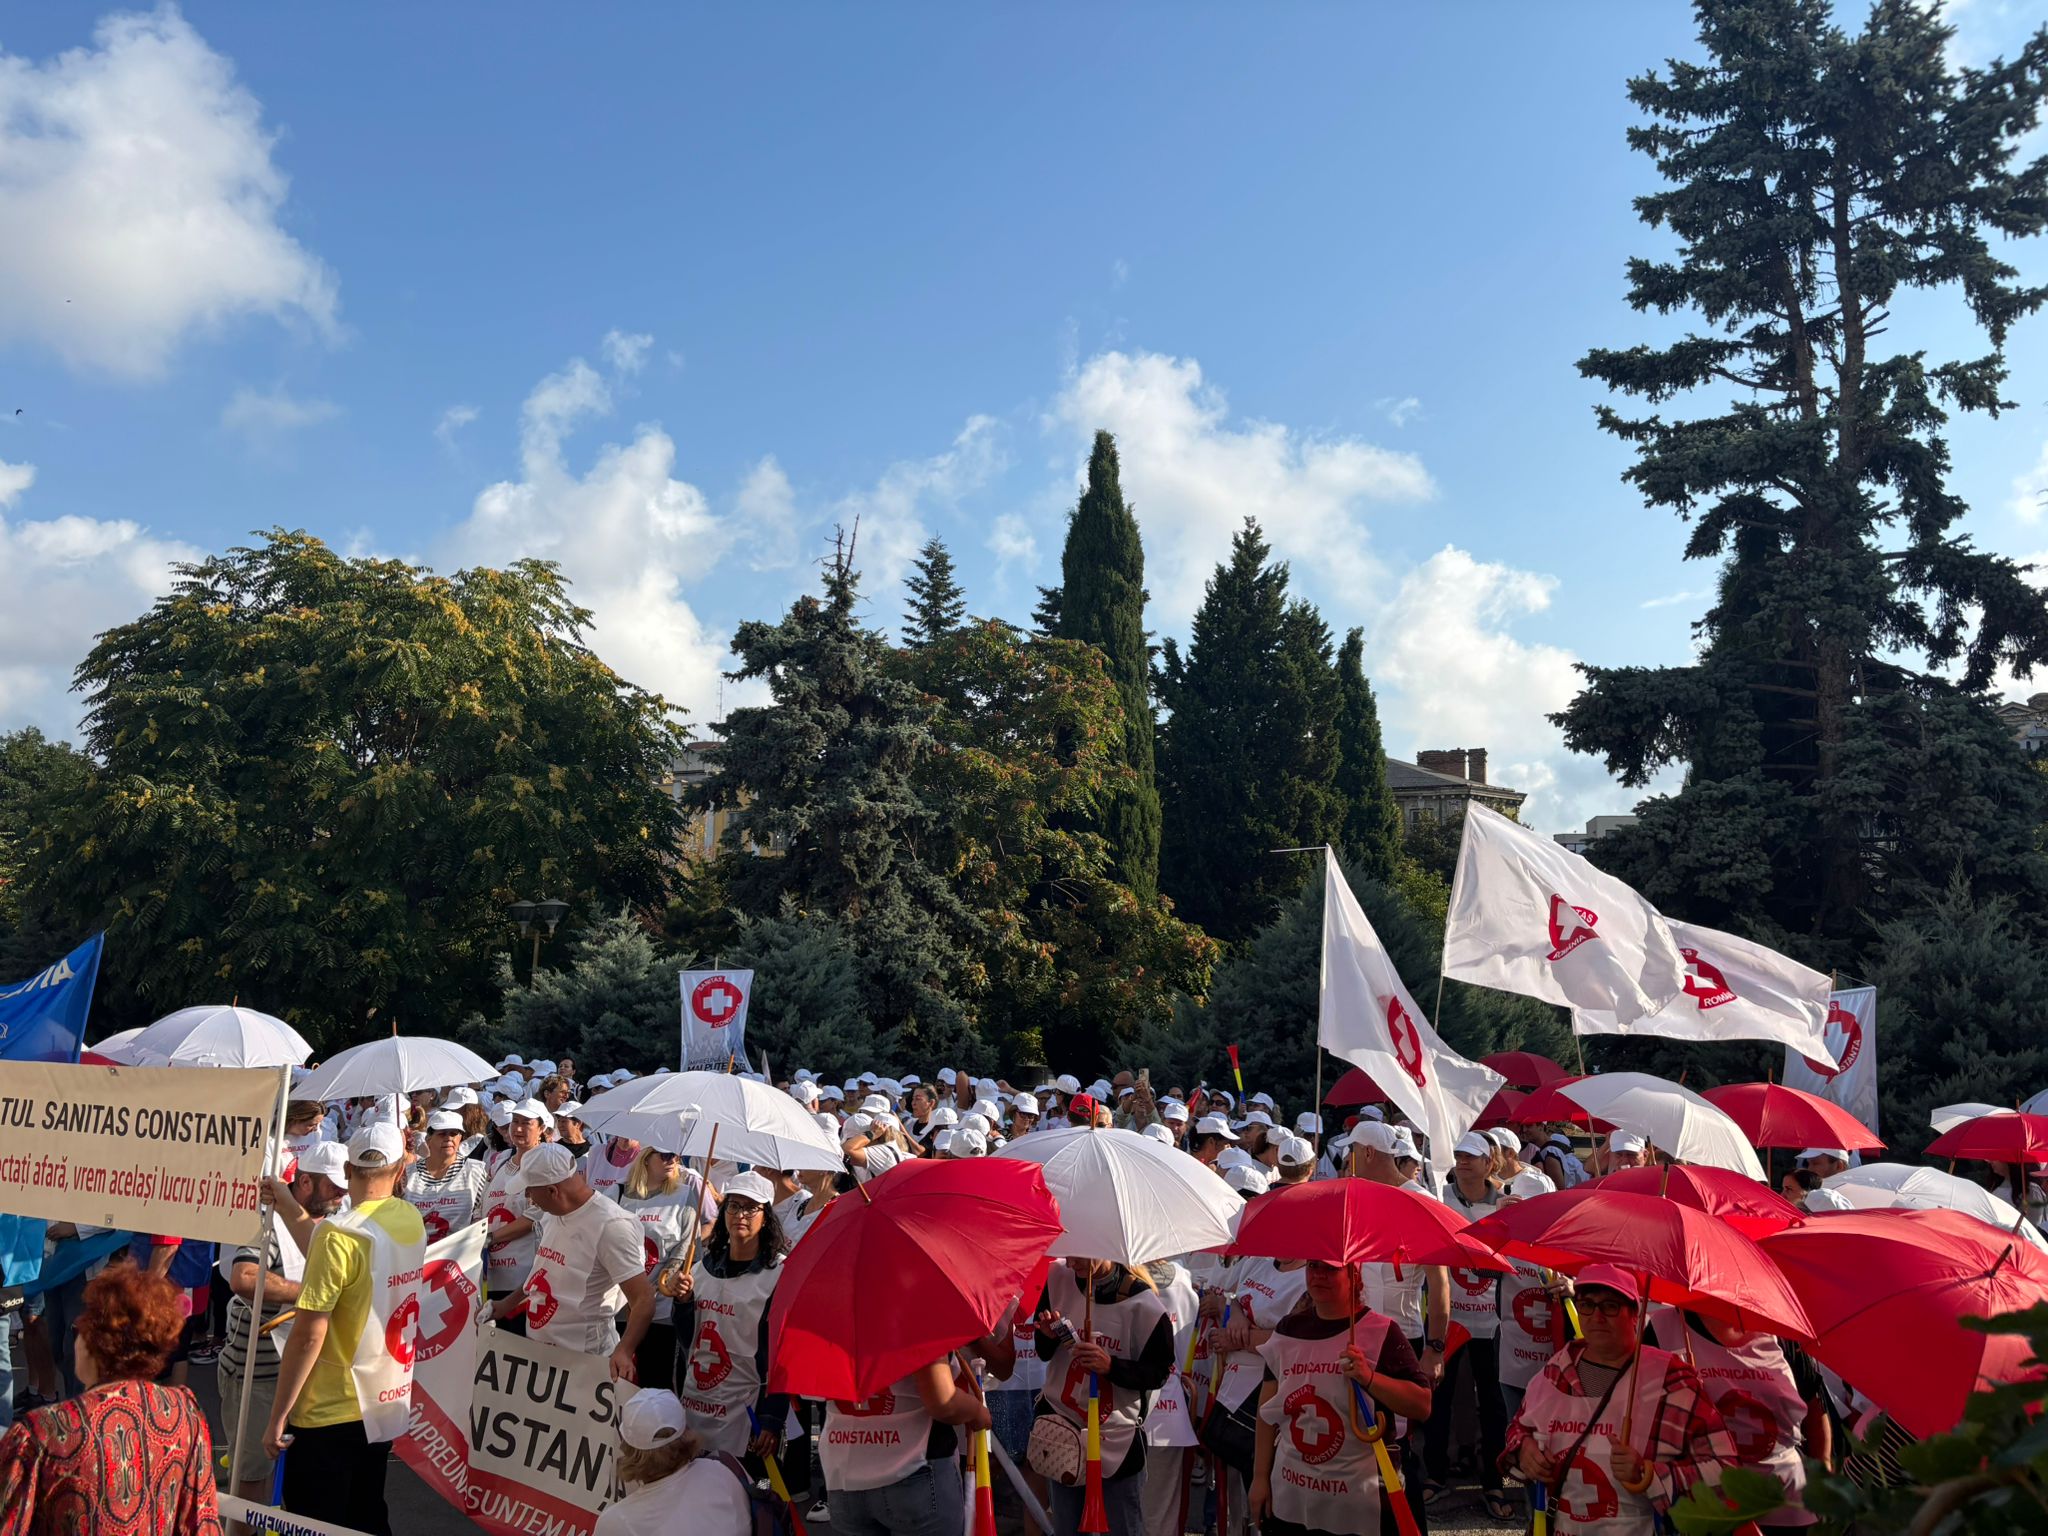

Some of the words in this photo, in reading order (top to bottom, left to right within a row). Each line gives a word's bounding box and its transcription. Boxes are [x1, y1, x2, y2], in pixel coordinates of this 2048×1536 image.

[42, 1101, 131, 1137] SANITAS
[135, 1108, 262, 1157] CONSTANȚA
[0, 1153, 31, 1192] ctați
[33, 1154, 69, 1193] afară,
[73, 1165, 107, 1195] vrem
[109, 1164, 159, 1208] același
[158, 1166, 196, 1205] lucru
[196, 1170, 212, 1214] și
[212, 1170, 228, 1208] în
[444, 1261, 473, 1294] SANITAS
[474, 1350, 577, 1415] ATUL
[829, 1431, 901, 1448] CONSTANȚA
[1548, 1420, 1617, 1437] SINDICTUL
[1281, 1466, 1348, 1496] CONSTANȚA
